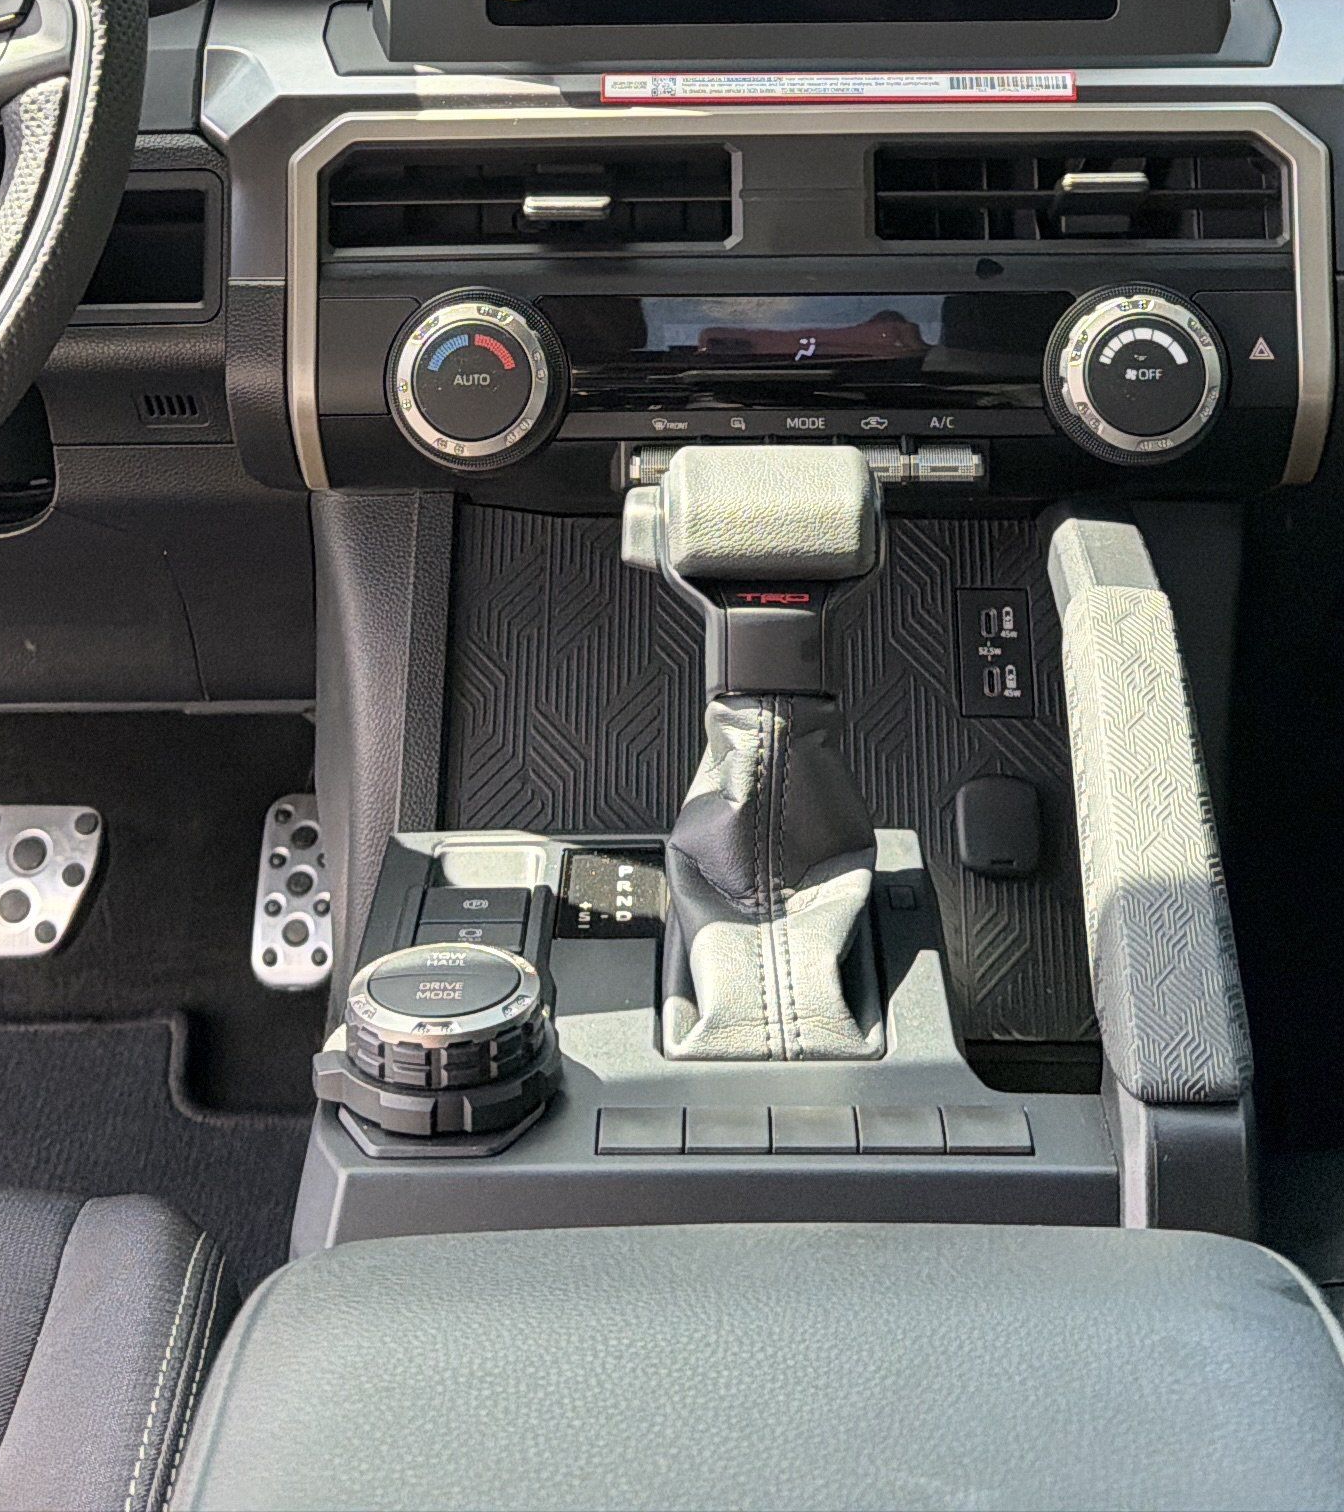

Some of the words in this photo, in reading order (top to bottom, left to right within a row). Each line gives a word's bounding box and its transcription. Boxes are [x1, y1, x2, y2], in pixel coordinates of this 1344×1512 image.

[453, 373, 491, 386] AUTO
[1138, 369, 1163, 380] OFF
[786, 417, 826, 430] MODE
[929, 416, 955, 429] A/C
[736, 593, 810, 604] TRD
[618, 864, 634, 878] P
[616, 880, 633, 892] R
[616, 895, 633, 907] N
[615, 910, 633, 922] D
[431, 951, 468, 960] TOW
[426, 959, 467, 967] HAUL
[418, 981, 464, 990] DRIVE
[415, 990, 463, 1000] MODE
